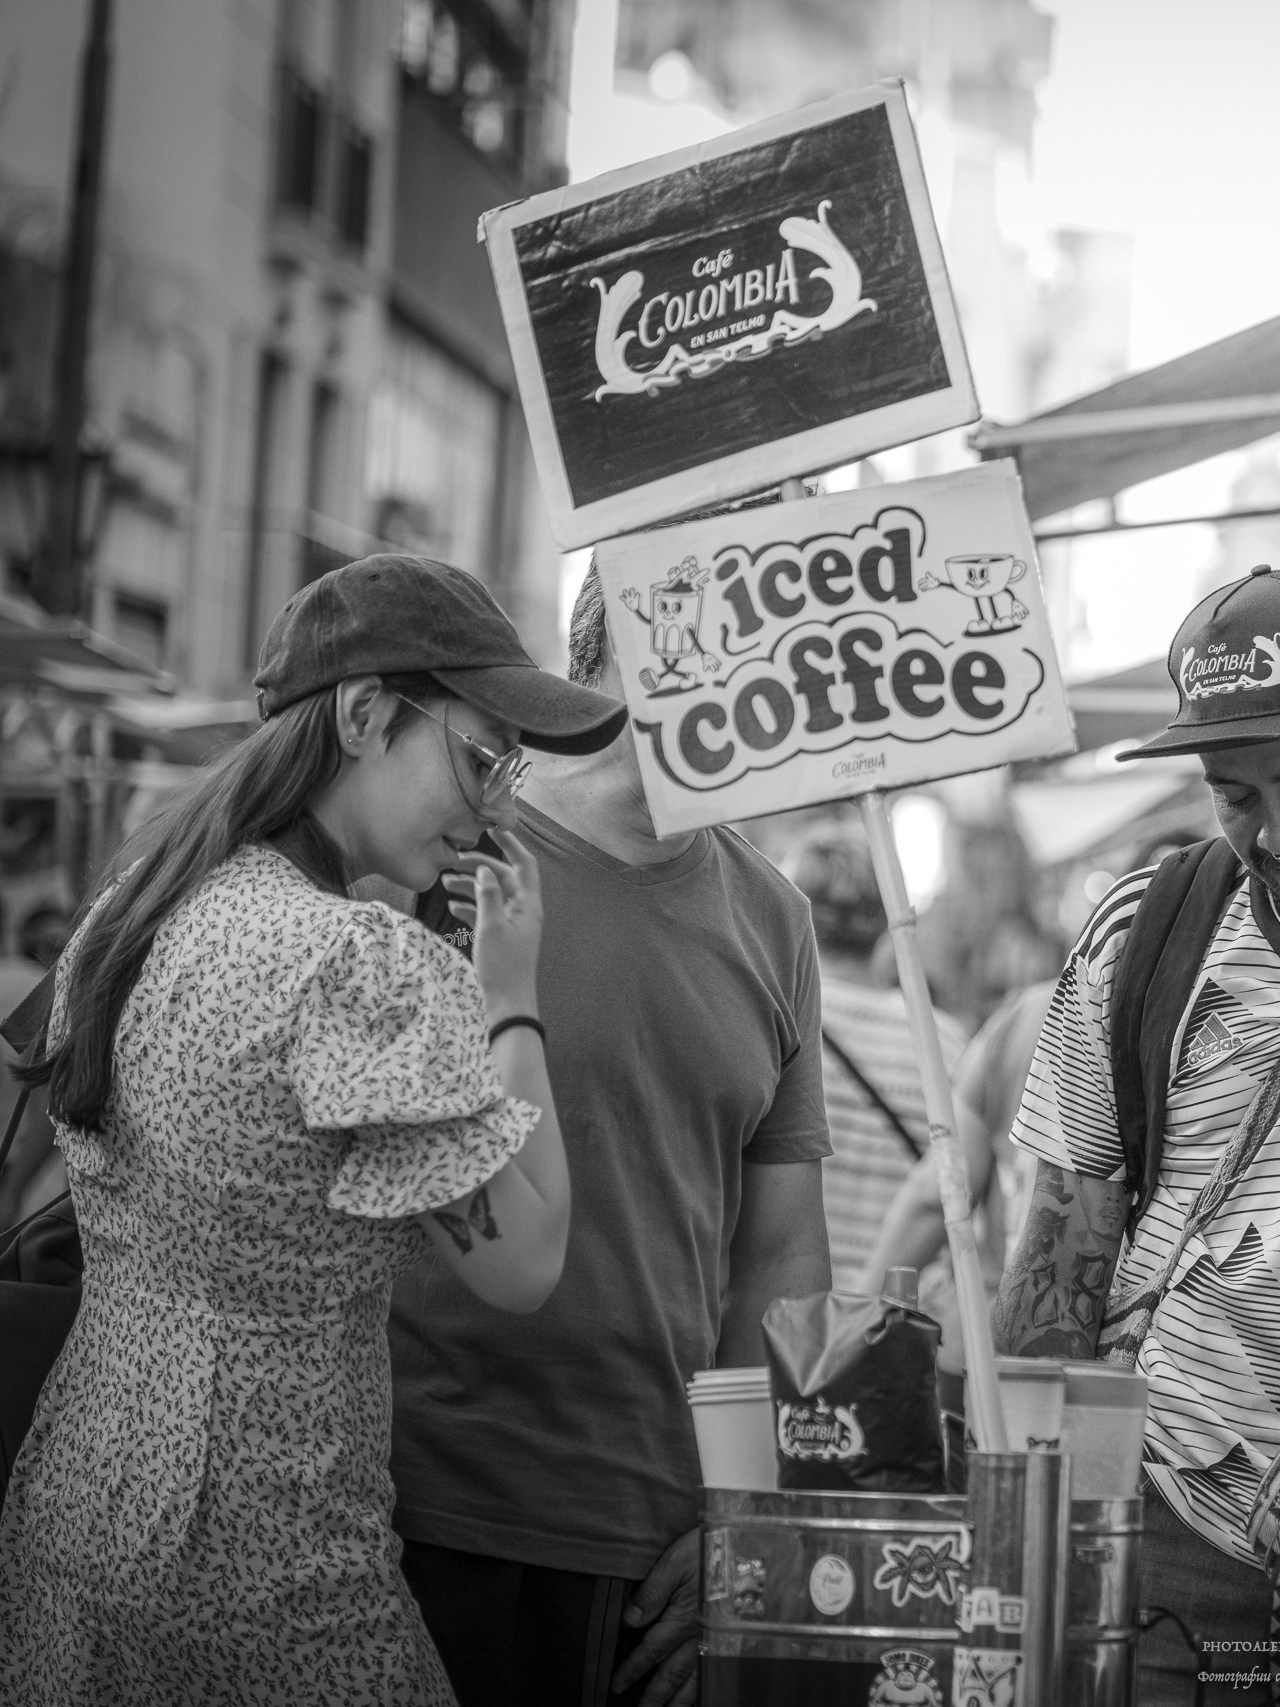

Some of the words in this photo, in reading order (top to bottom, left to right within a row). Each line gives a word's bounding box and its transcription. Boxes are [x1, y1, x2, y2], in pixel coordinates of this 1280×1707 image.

[692, 248, 734, 278] Café
[638, 248, 799, 348] COLOMBIA
[690, 335, 706, 348] EN
[706, 326, 728, 343] SAN
[729, 314, 766, 335] TELMO
[715, 528, 917, 637] iced
[1207, 643, 1227, 654] Café
[1189, 648, 1257, 682] COLOMBIA
[679, 628, 1006, 775] coffee
[832, 753, 885, 778] COLOMBIA
[1188, 1036, 1243, 1066] adidas
[788, 1421, 840, 1445] COLOMBIA
